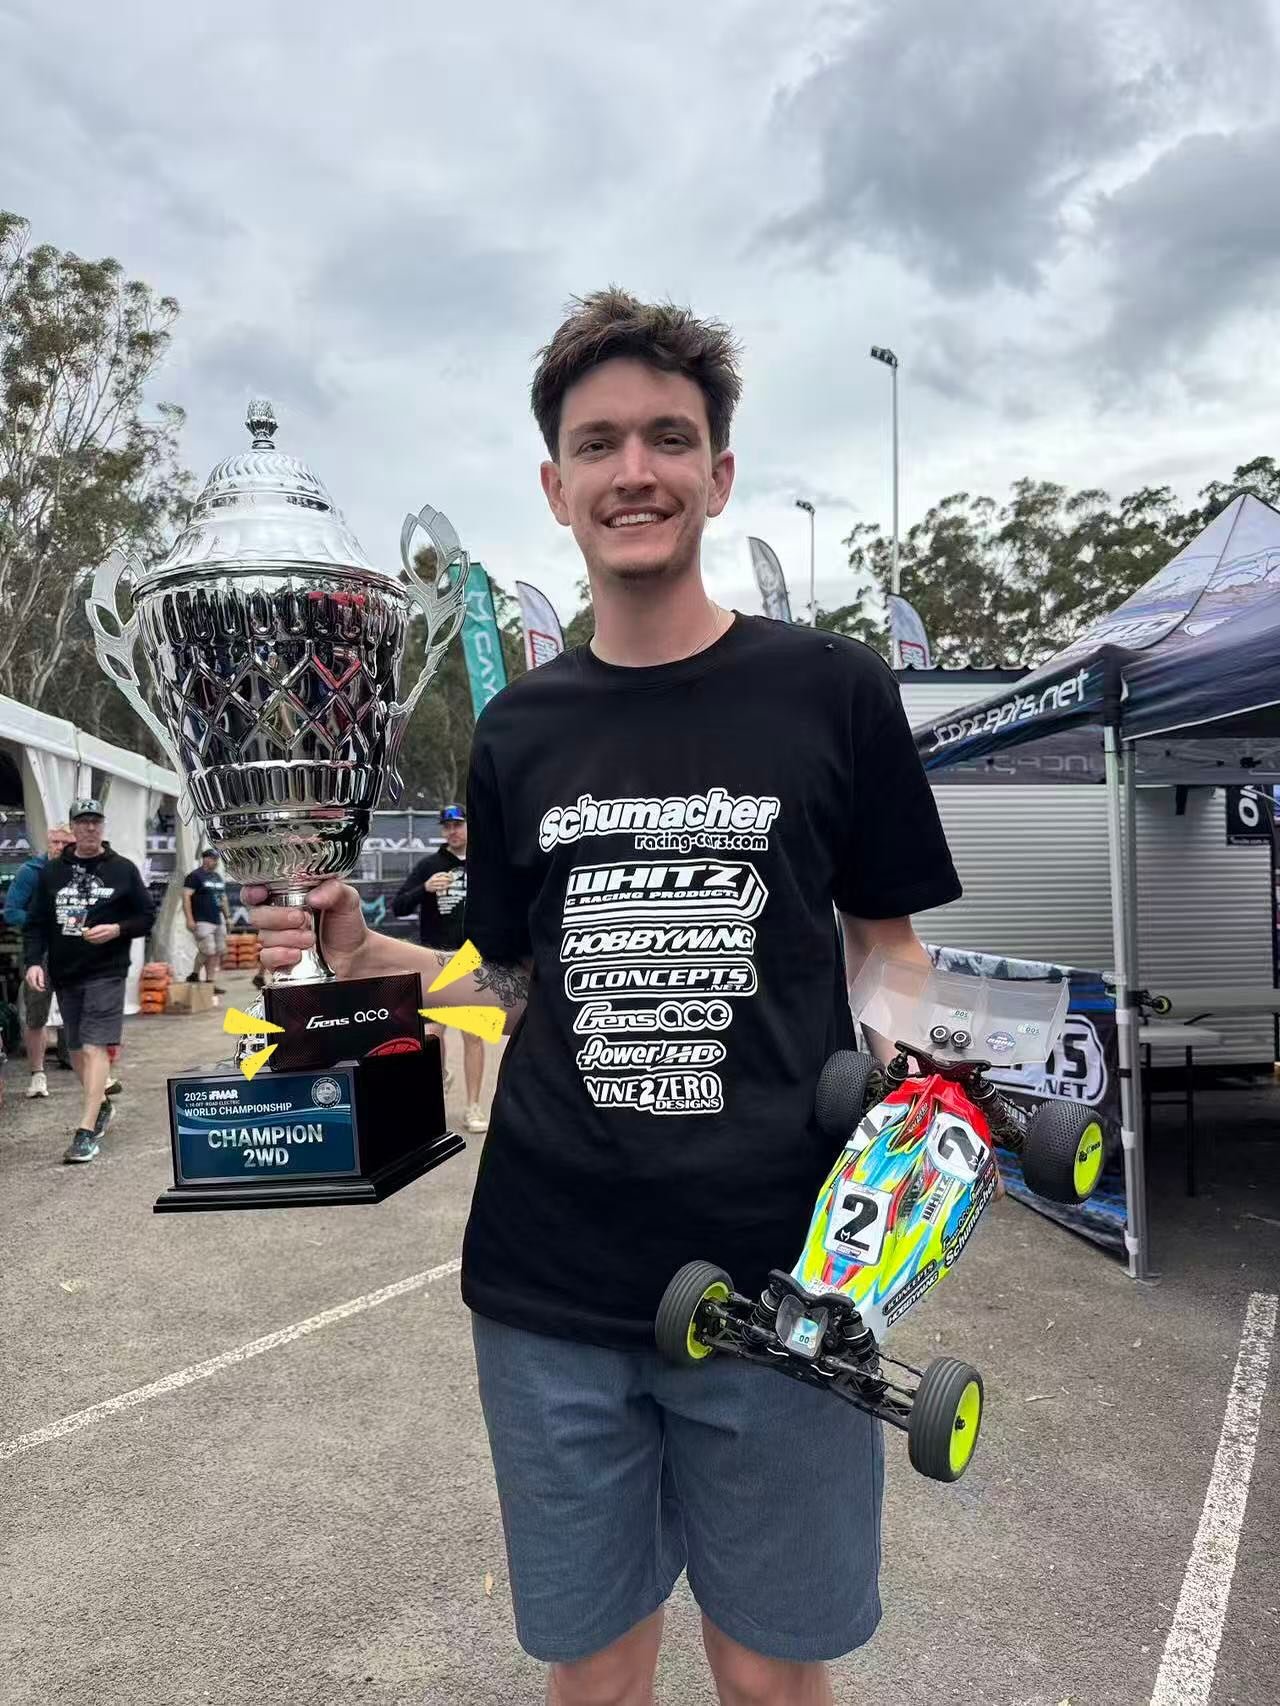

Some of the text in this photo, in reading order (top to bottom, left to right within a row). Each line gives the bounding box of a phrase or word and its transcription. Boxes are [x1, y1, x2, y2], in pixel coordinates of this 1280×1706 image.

[636, 833, 768, 851] racing-cars.com
[568, 865, 743, 895] WHITZ
[579, 891, 643, 904] RACING
[648, 889, 739, 899] PRODUCTS
[562, 928, 753, 957] HOBBYWING
[573, 968, 749, 990] JCONCEPTS
[306, 1008, 389, 1030] Gens ace
[184, 1091, 208, 1102] 2025
[655, 1100, 720, 1110] DESIGNS
[184, 1102, 292, 1117] WORLD CHAMPIONSHIP
[207, 1123, 323, 1148] CHAMPION
[243, 1148, 289, 1168] 2WD
[938, 1126, 985, 1172] 2
[834, 1193, 878, 1252] 2
[945, 1176, 996, 1267] Schumacher
[888, 1273, 938, 1325] HOBBYWING
